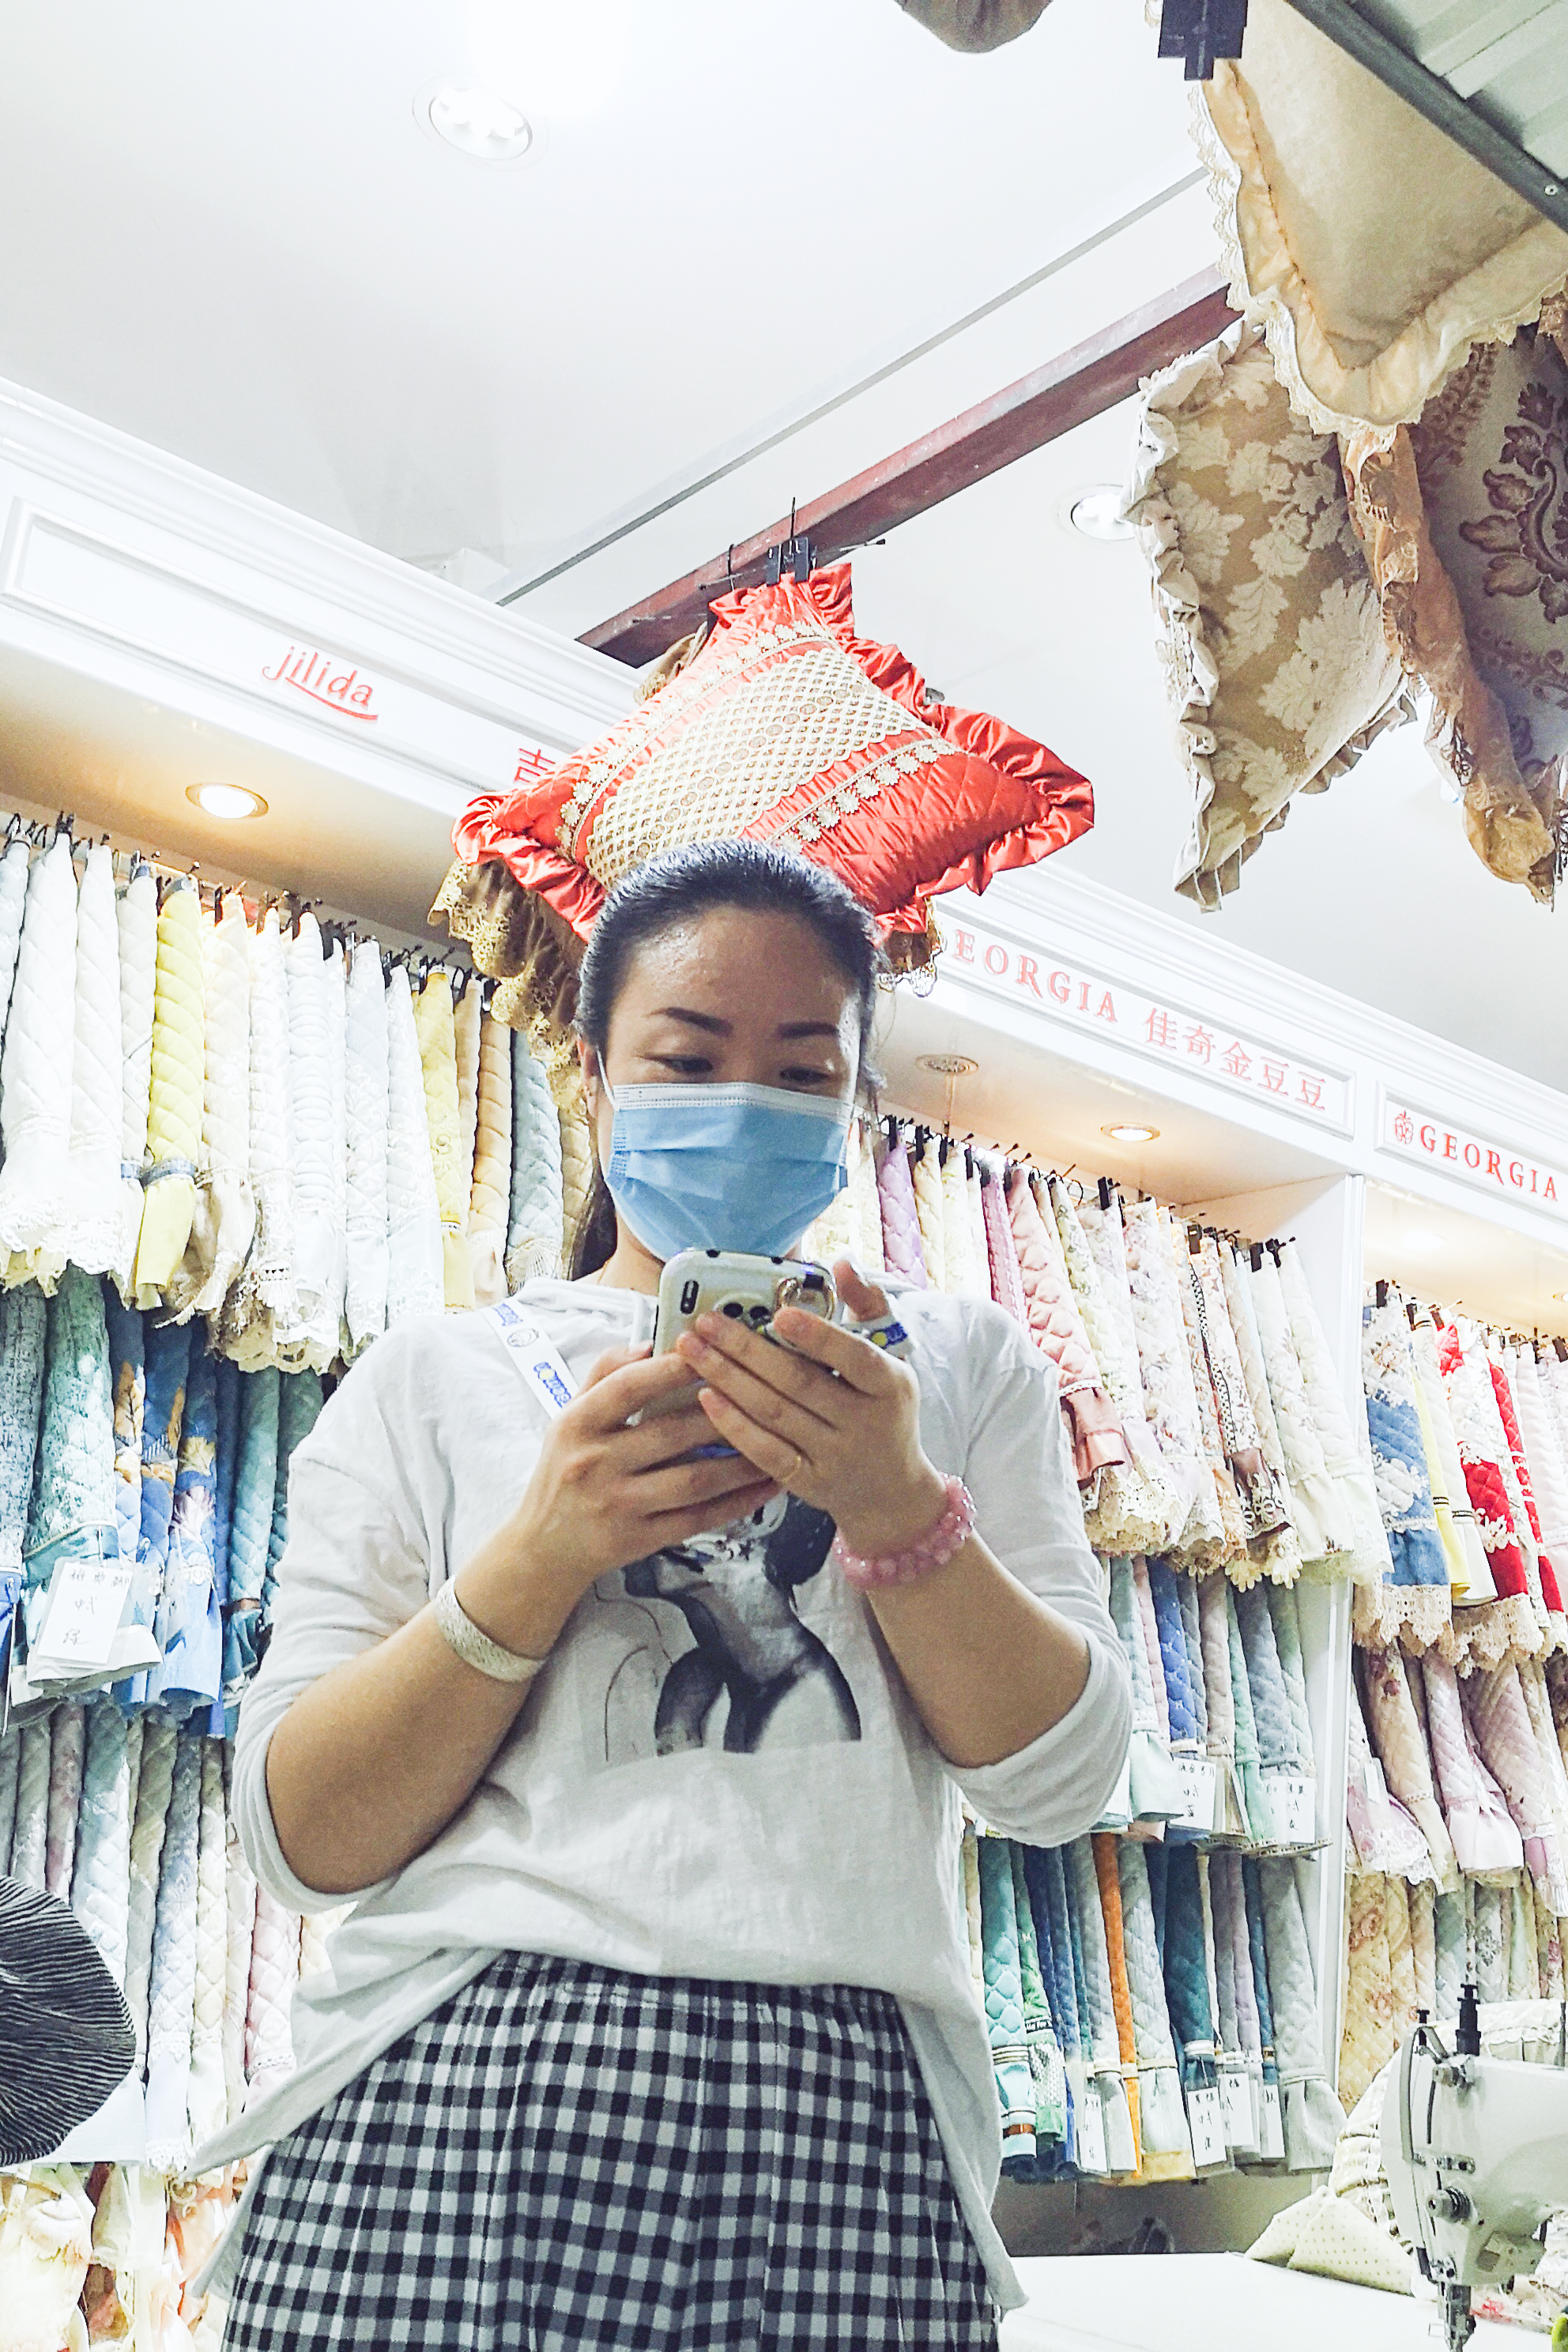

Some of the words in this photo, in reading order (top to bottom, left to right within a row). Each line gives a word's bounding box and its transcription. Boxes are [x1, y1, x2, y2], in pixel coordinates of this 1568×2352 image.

[262, 646, 374, 713] jilida
[954, 929, 1118, 1023] EORGIA
[1143, 1007, 1326, 1110] 佳奇金豆豆
[1419, 1124, 1558, 1202] GEORGIA
